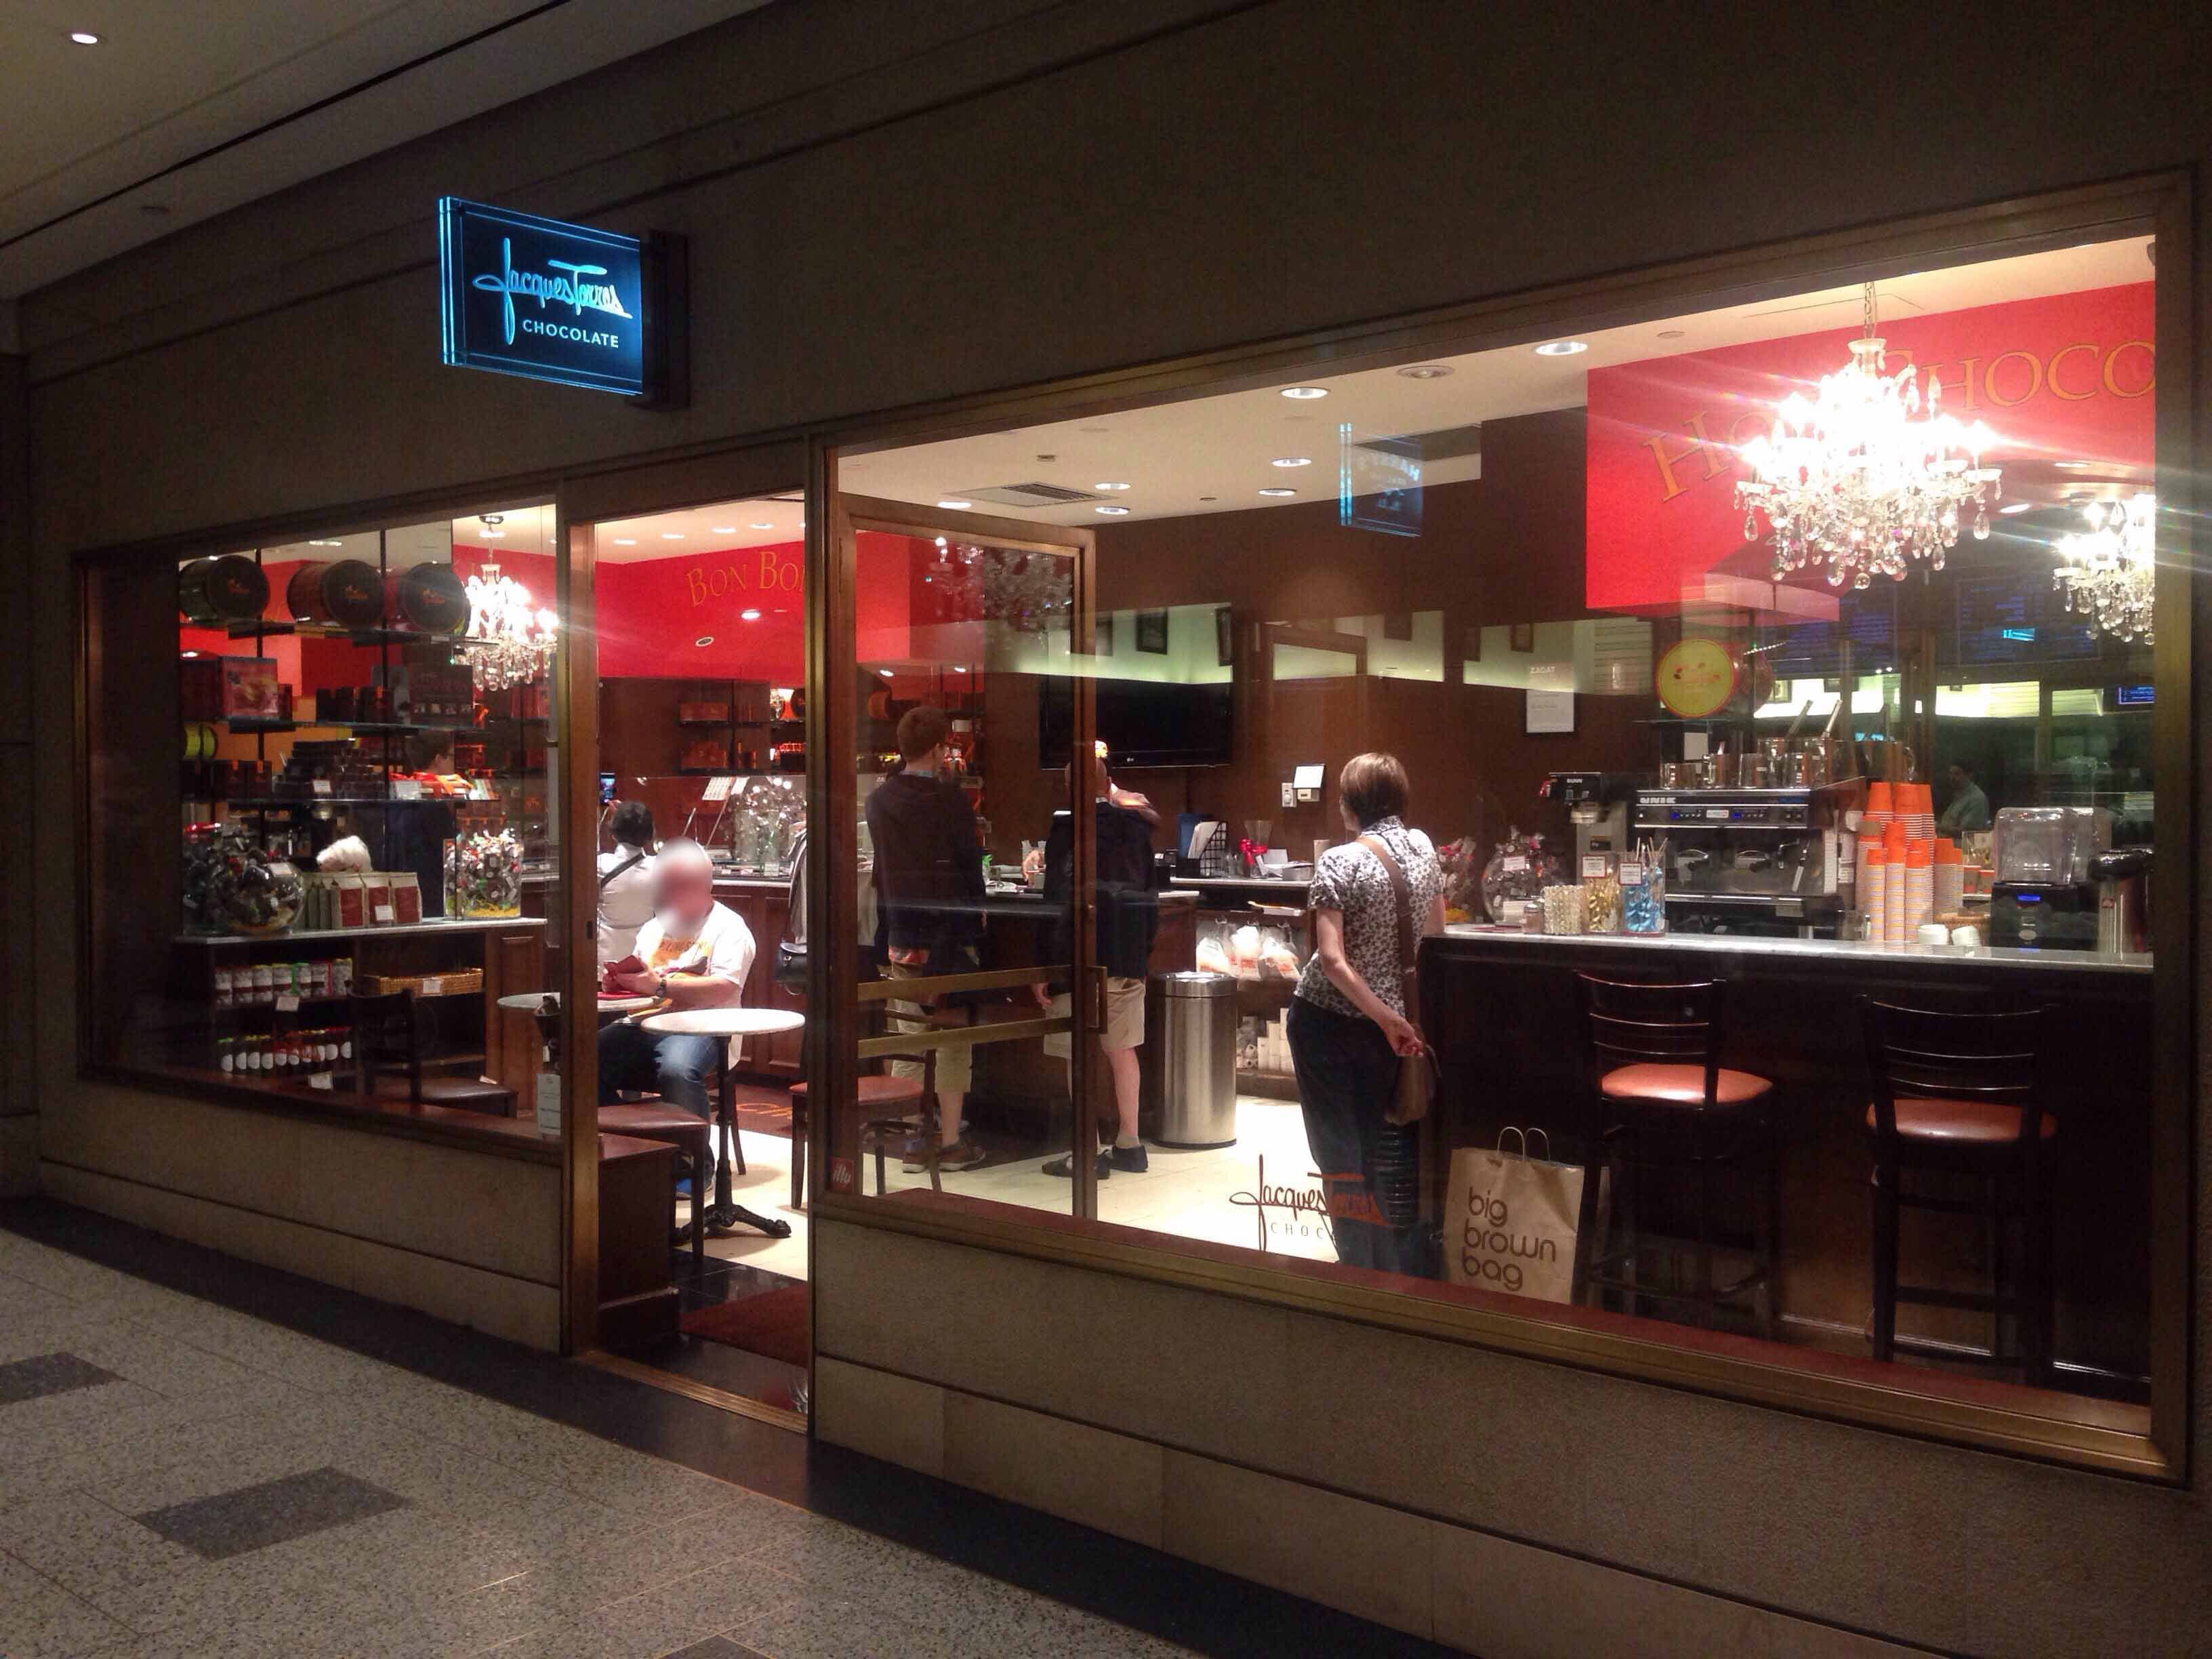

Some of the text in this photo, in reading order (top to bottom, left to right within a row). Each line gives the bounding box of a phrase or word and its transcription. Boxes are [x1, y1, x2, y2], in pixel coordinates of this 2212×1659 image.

[472, 238, 575, 345] Jacques
[522, 319, 619, 348] CHOCOLATE
[1640, 408, 1789, 504] HO
[758, 551, 805, 591] BO
[1229, 1154, 1330, 1252] Jacques
[1469, 1187, 1508, 1228] big
[1464, 1218, 1557, 1262] brown
[1462, 1246, 1523, 1292] bag
